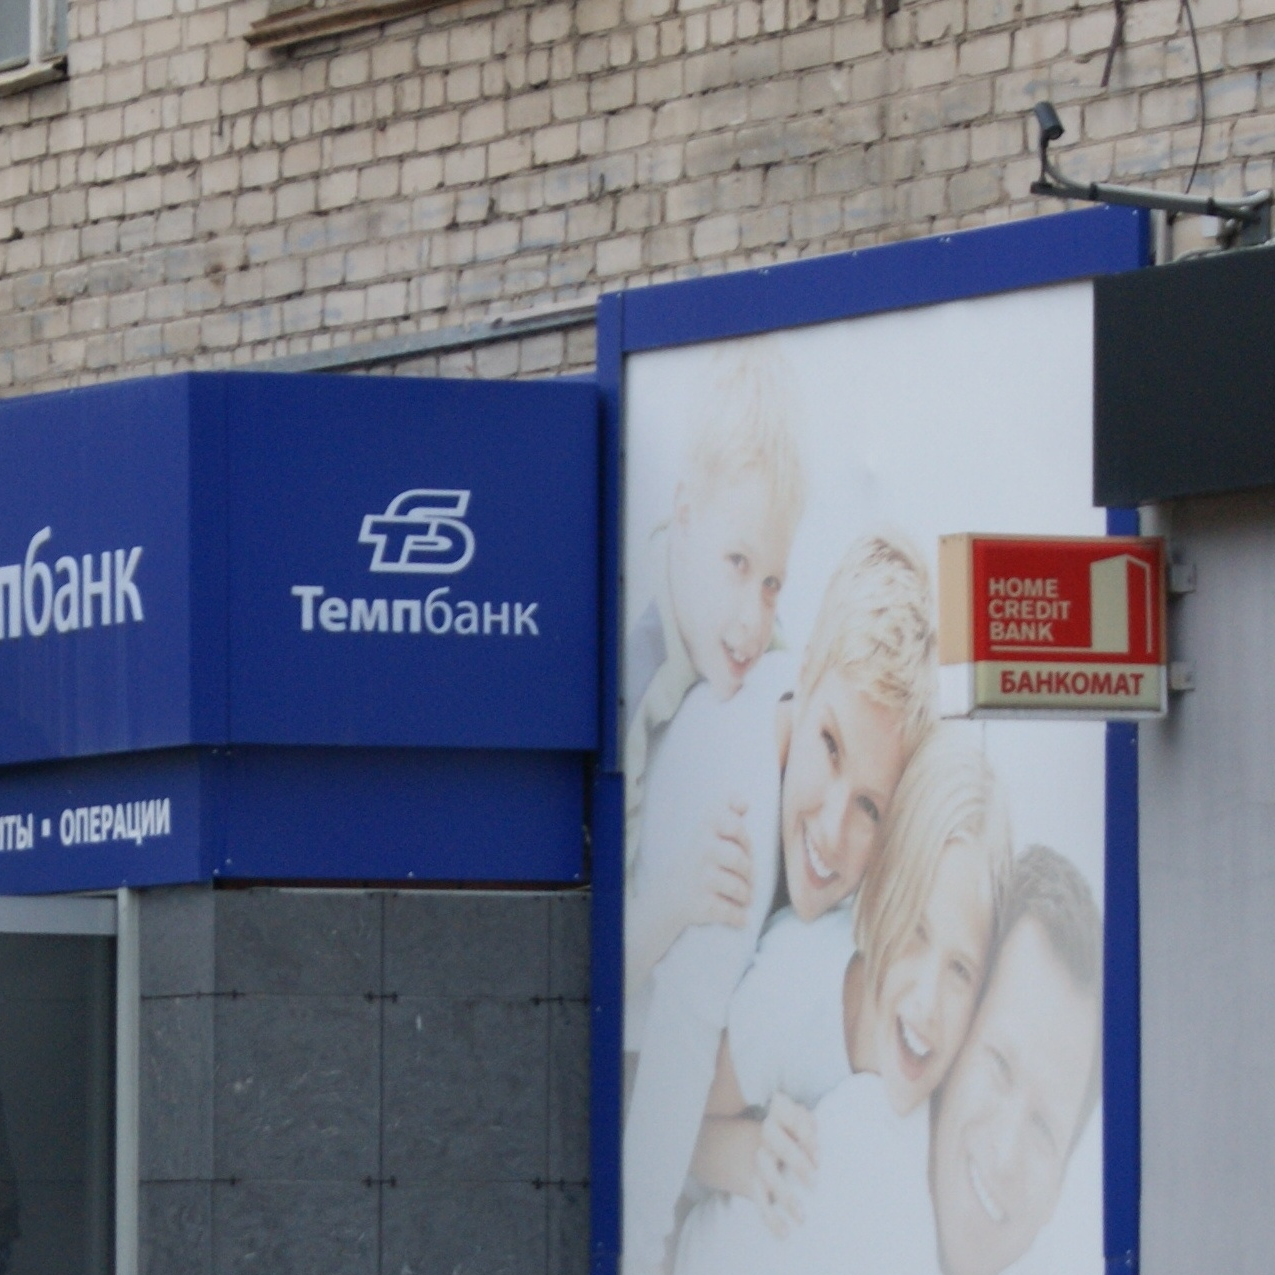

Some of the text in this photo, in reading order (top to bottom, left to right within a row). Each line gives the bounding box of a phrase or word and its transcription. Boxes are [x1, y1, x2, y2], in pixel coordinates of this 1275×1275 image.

[988, 577, 1059, 599] HOME
[290, 584, 541, 637] Темпбанк
[988, 599, 1071, 621] CREDIT
[989, 621, 1054, 642] BANK
[999, 670, 1145, 696] БАНКОМАТ
[59, 797, 171, 845] ОПЕРАЦИИ
